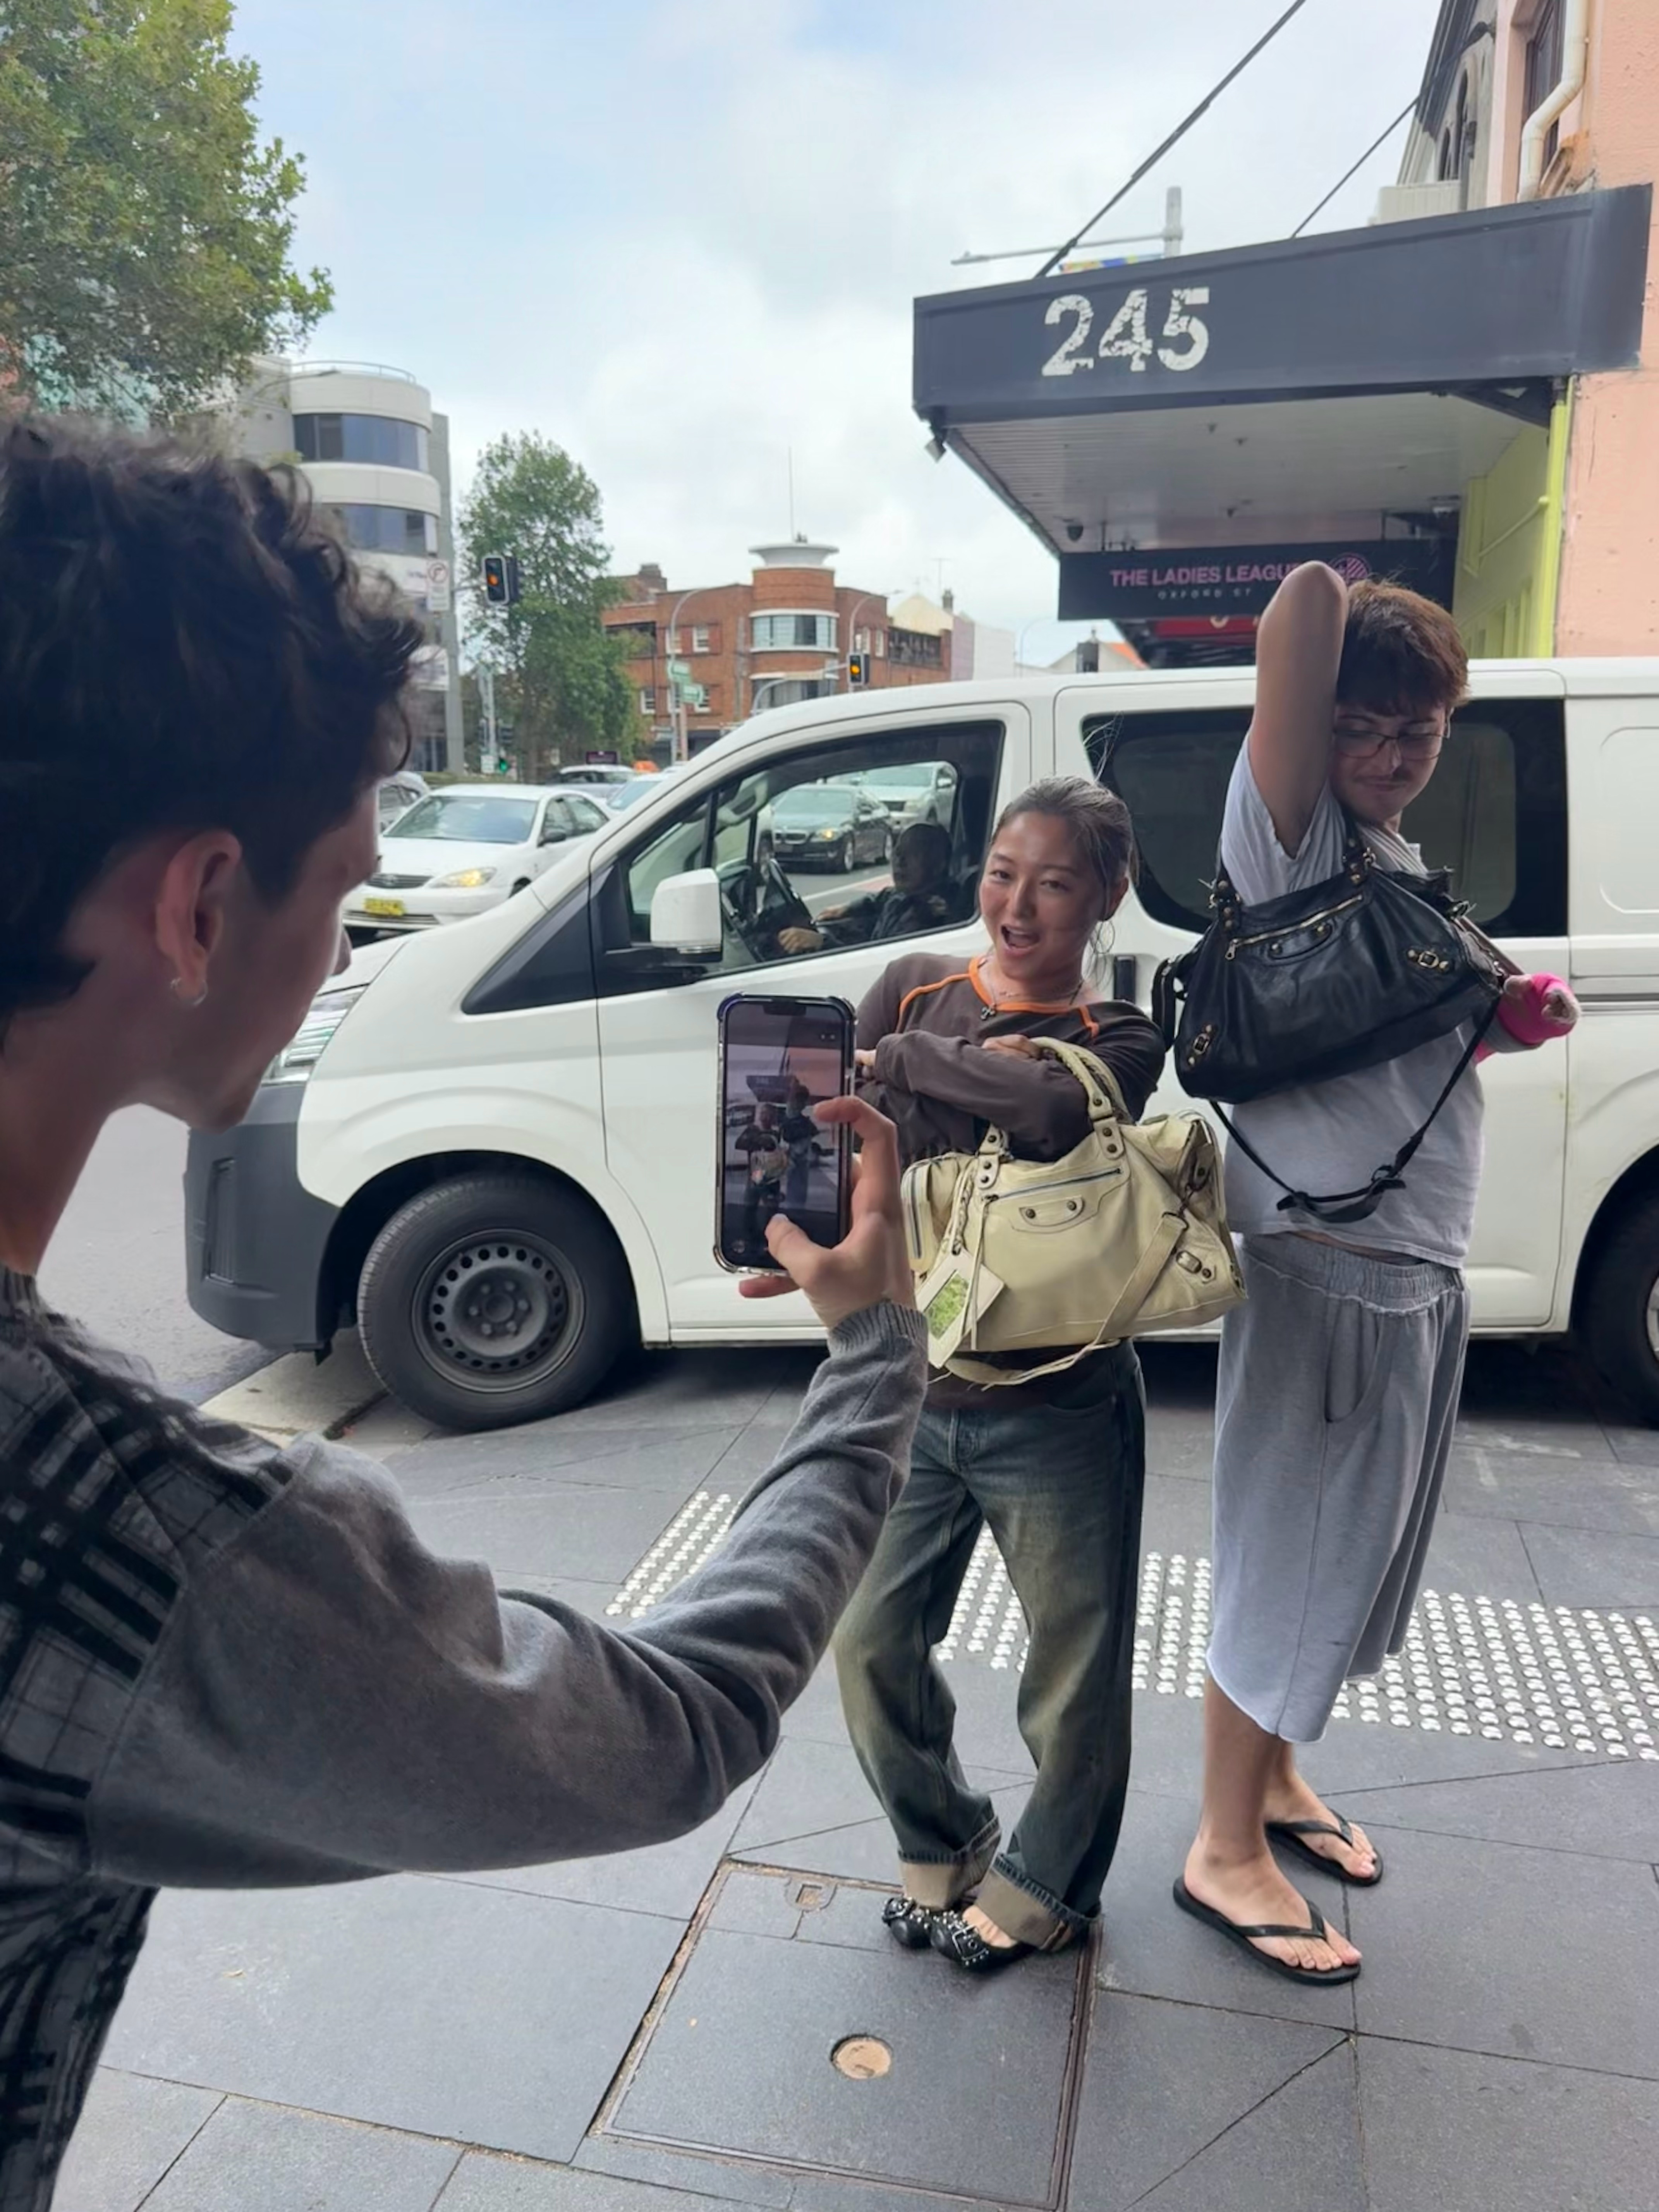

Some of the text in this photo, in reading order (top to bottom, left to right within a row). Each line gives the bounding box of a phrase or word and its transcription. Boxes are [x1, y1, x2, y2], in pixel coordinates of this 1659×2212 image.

[1042, 287, 1209, 376] 245
[1110, 563, 1298, 587] THE LADIES LEAGU
